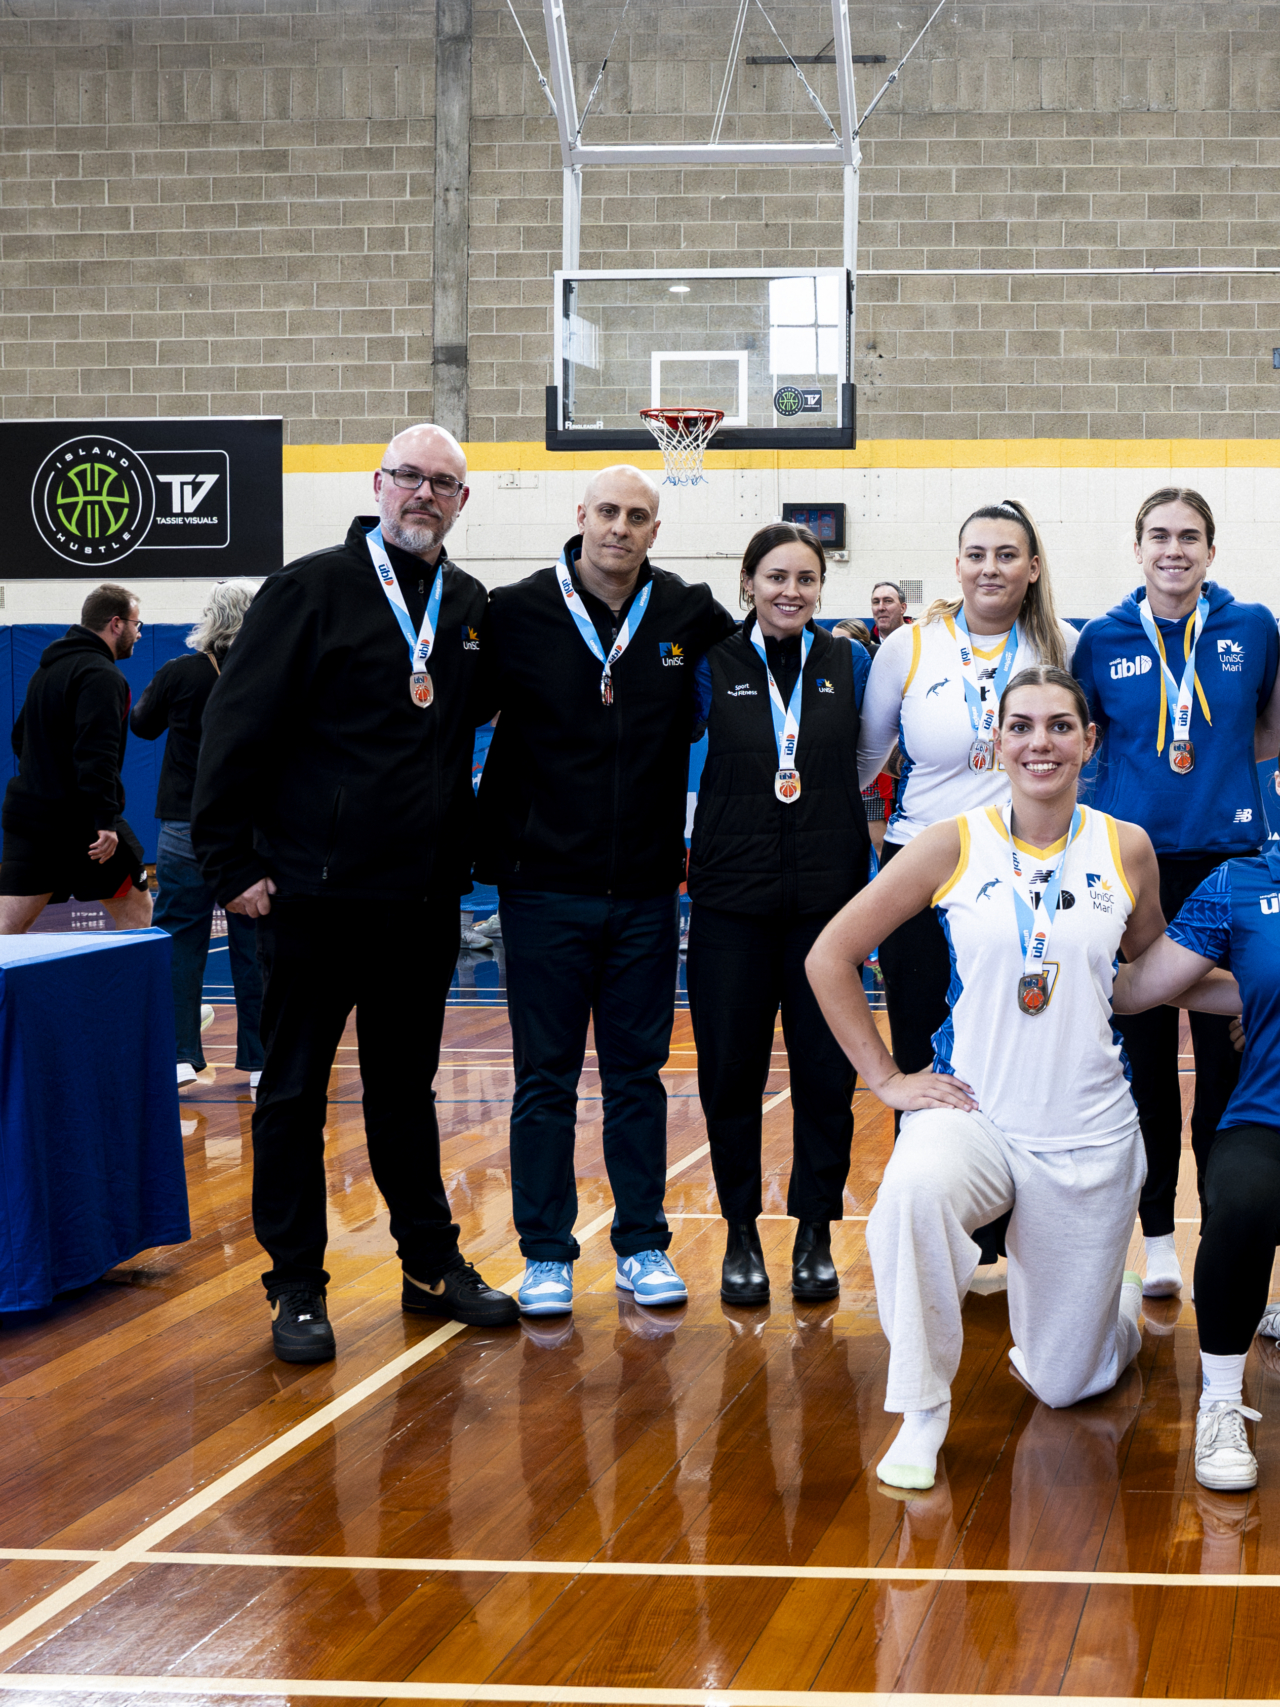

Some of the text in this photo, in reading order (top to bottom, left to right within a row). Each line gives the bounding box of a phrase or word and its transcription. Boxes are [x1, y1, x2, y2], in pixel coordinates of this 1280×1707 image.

[56, 446, 130, 468] ISLAND
[156, 474, 220, 513] TV
[156, 516, 218, 525] TASSIE VISUALS
[56, 531, 131, 554] HUSTLE
[462, 641, 480, 650] UniSC
[662, 656, 684, 667] UniSC
[960, 647, 971, 662] ubl
[1219, 653, 1244, 663] UniSC
[1110, 656, 1142, 680] ubl
[1221, 663, 1242, 672] Mari
[1089, 889, 1115, 904] UniSC
[1092, 902, 1113, 914] Mari
[1032, 937, 1046, 958] ubl
